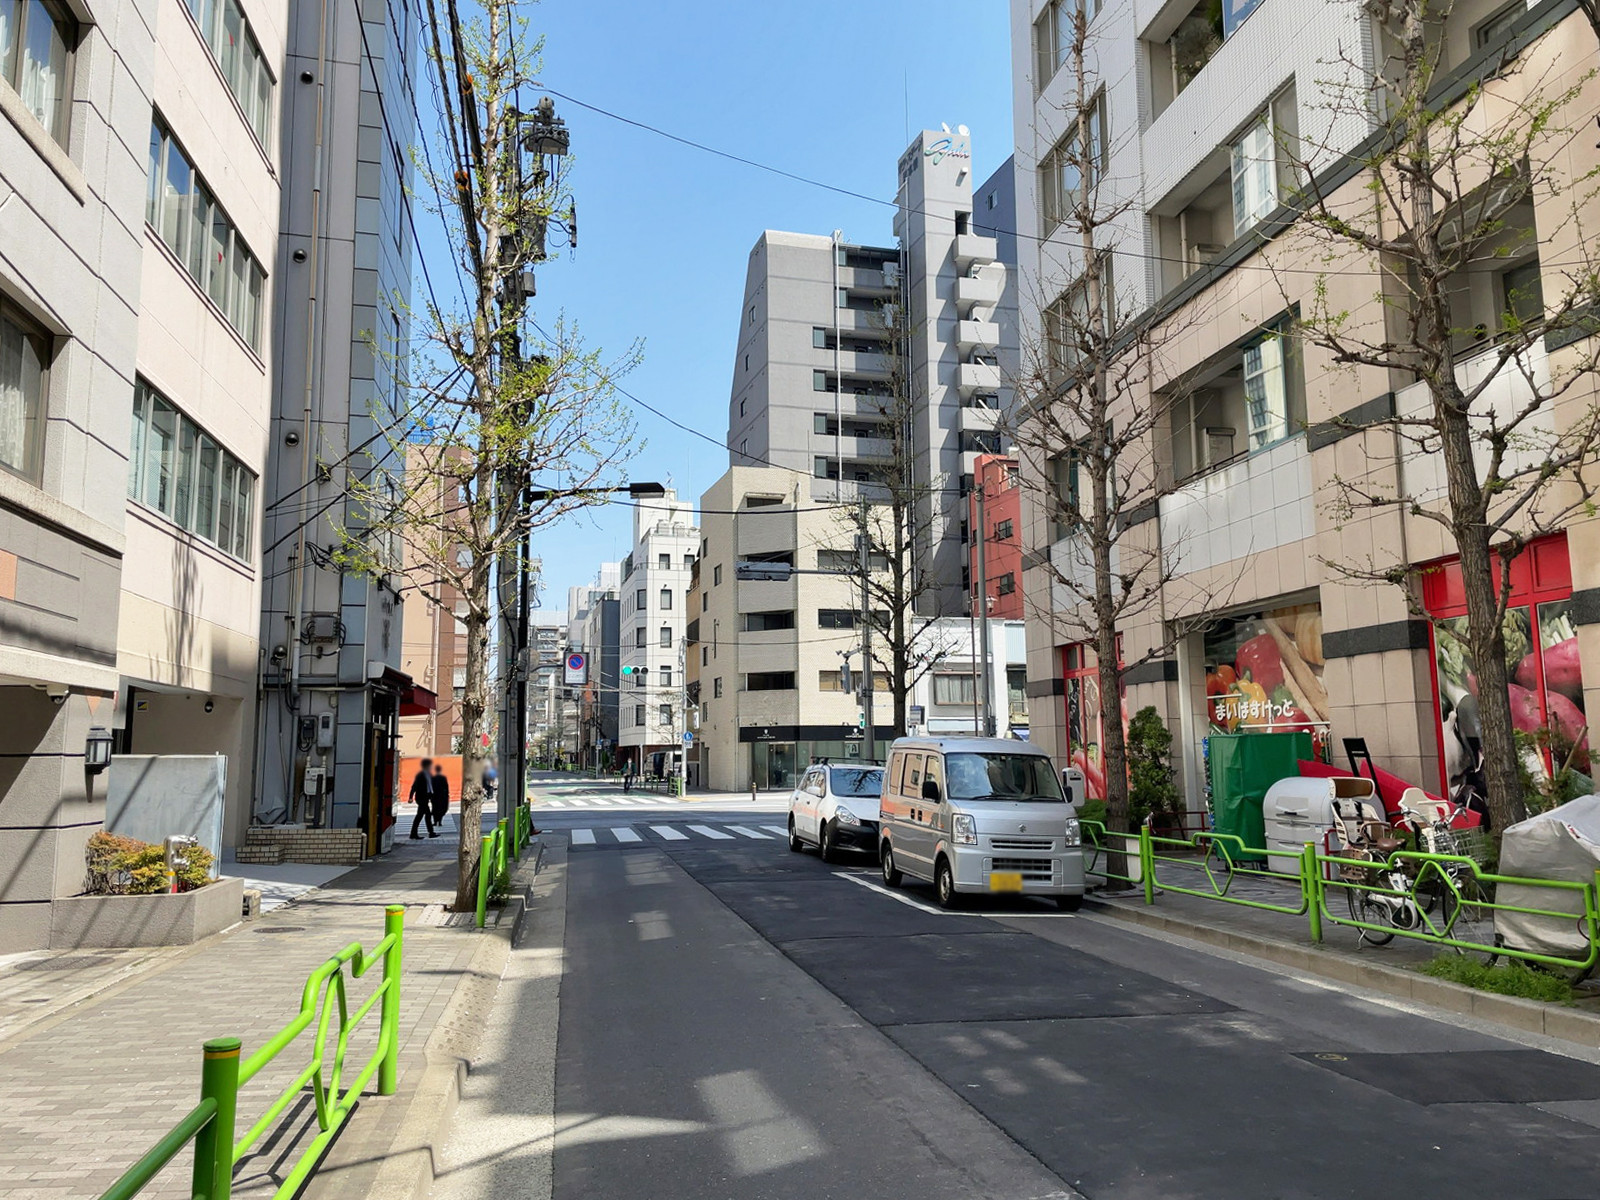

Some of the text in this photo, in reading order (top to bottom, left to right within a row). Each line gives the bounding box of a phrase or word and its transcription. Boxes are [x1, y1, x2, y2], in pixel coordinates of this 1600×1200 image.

[1215, 698, 1294, 721] まいばすけっと
